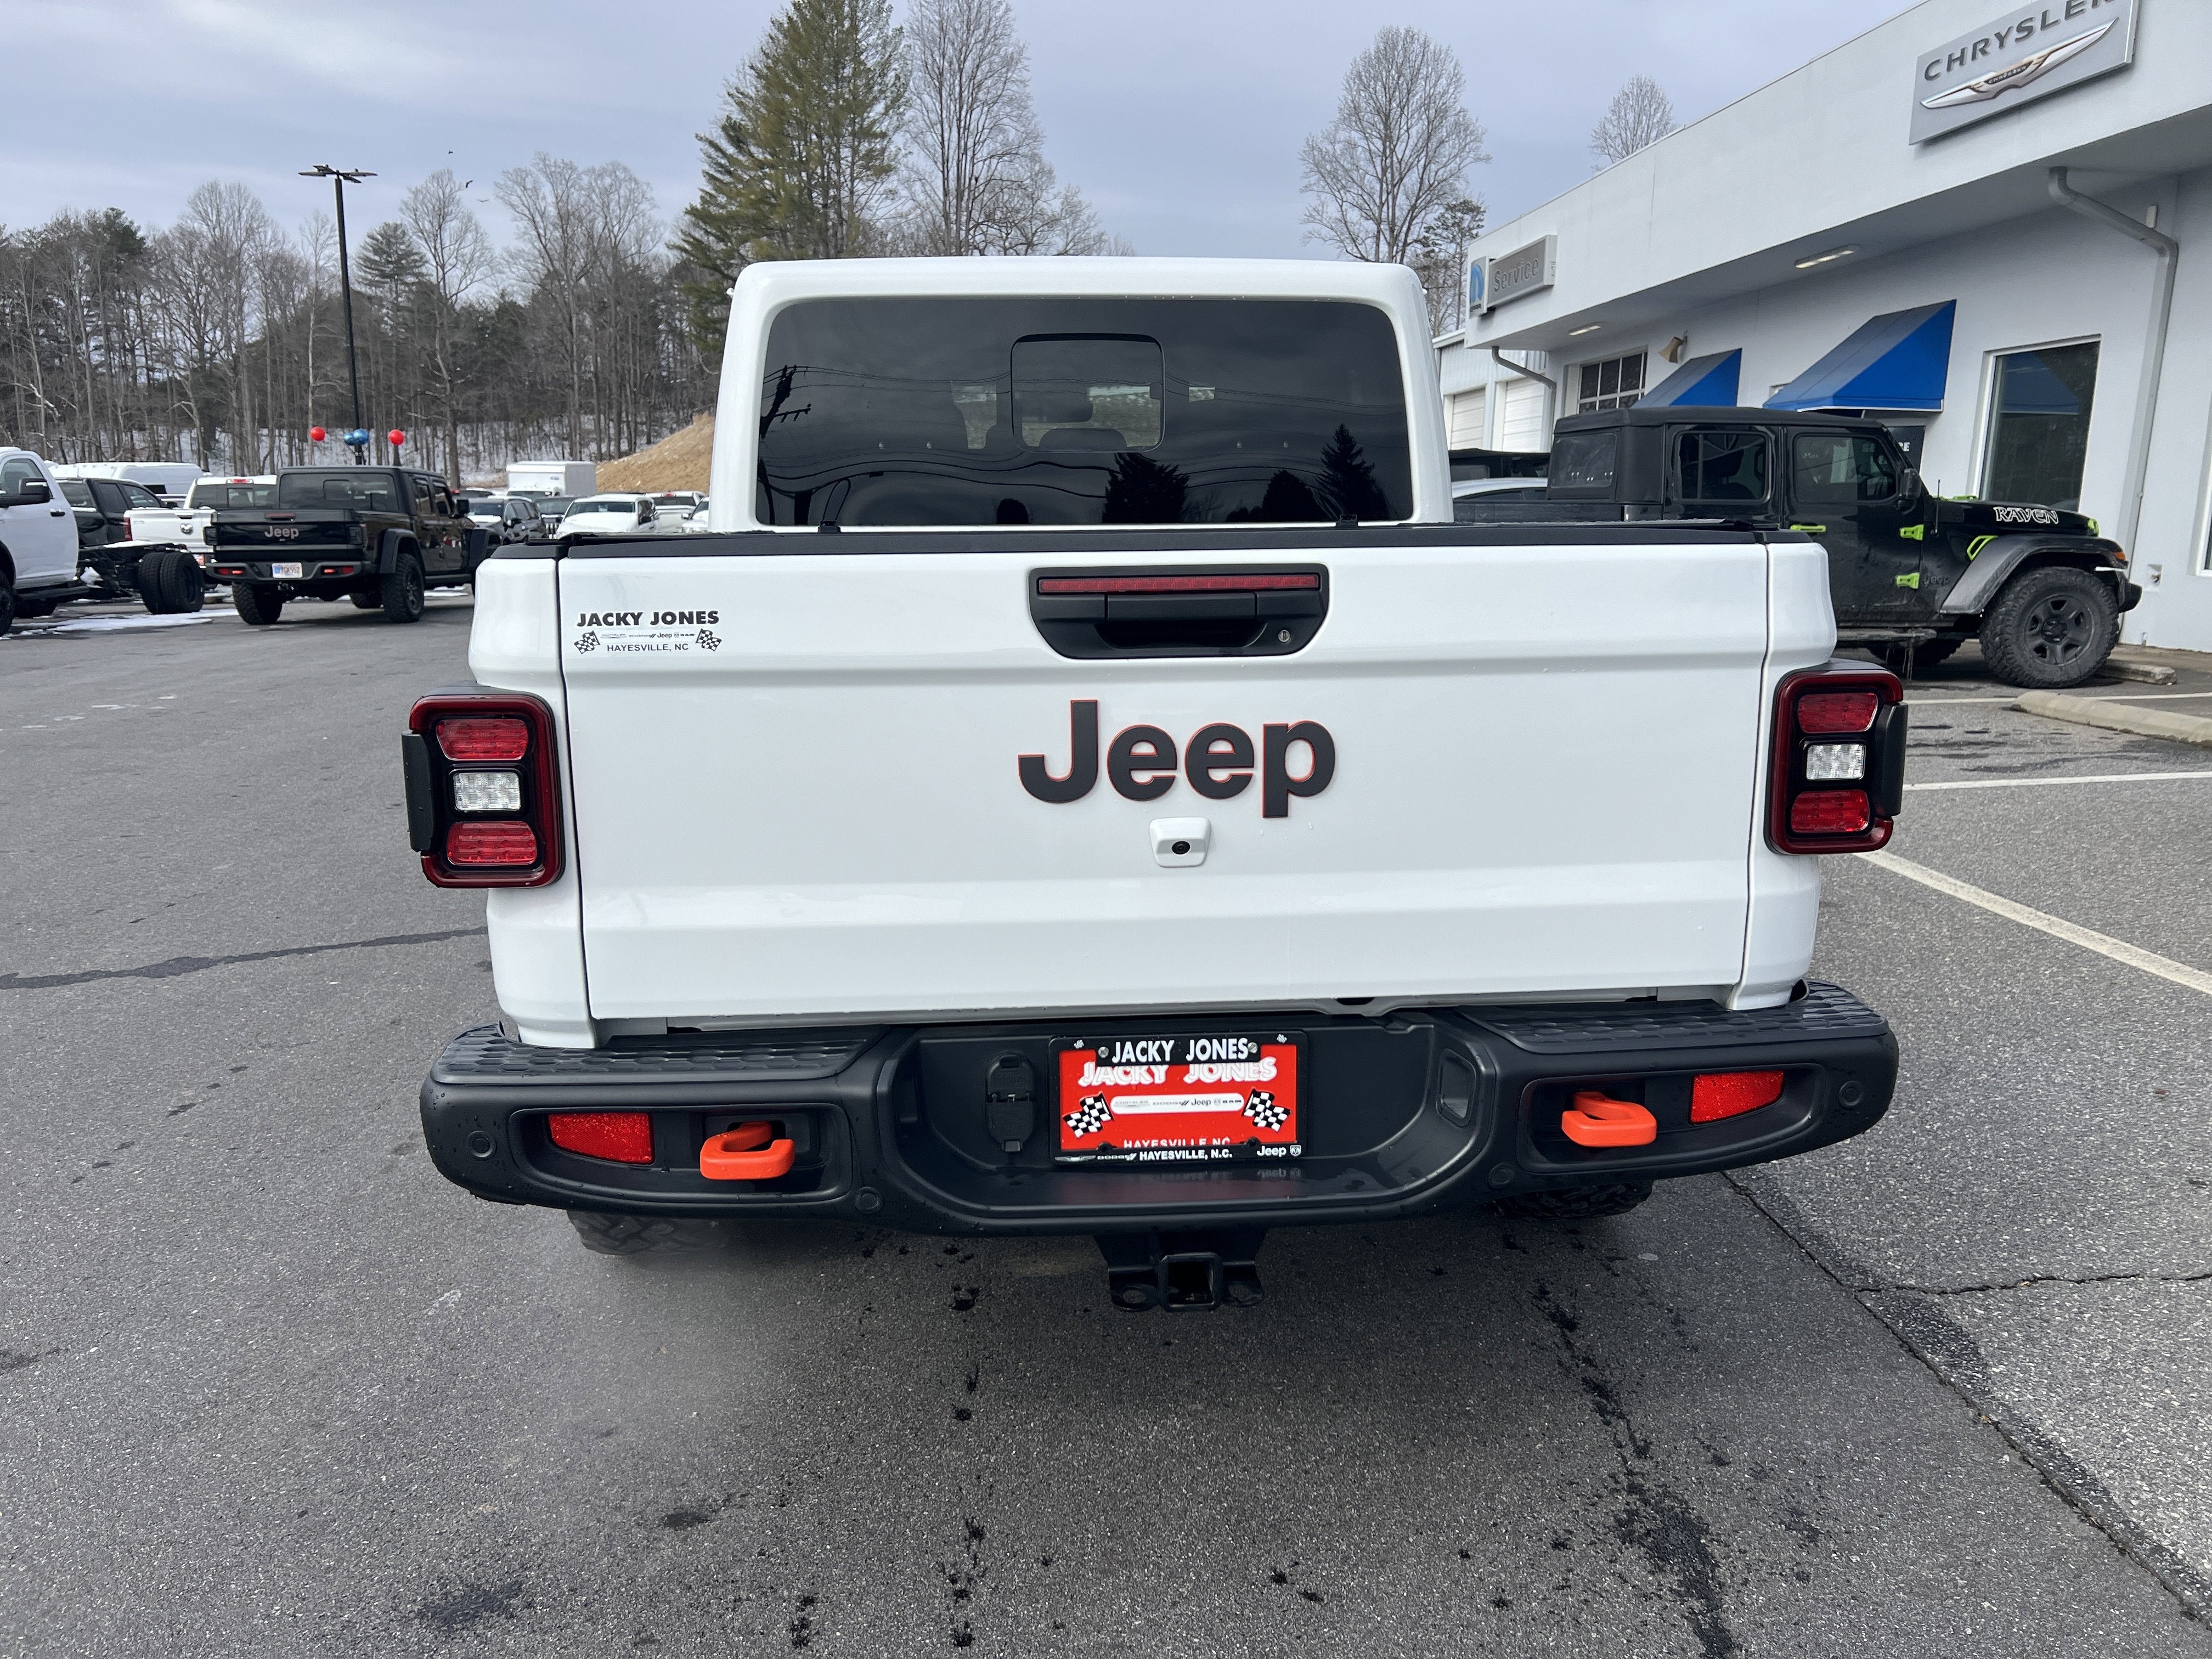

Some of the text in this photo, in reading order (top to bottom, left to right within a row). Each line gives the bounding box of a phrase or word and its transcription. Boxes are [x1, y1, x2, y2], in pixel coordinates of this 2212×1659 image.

[1924, 0, 2114, 81] CHRYSLE
[1493, 258, 1539, 292] Service
[1993, 506, 2059, 524] RAVEN
[264, 526, 299, 539] Jeep
[577, 611, 719, 627] JACKY JONES
[607, 644, 672, 652] HAYESVILLE,
[1018, 699, 1335, 818] Jeep
[1111, 1037, 1249, 1064] JACKY JONES
[1078, 1056, 1277, 1087] JACKY JONES
[1139, 1149, 1208, 1161] HAYESVILLE,
[1211, 1149, 1233, 1158] N.C.
[1256, 1146, 1286, 1157] Jeep
